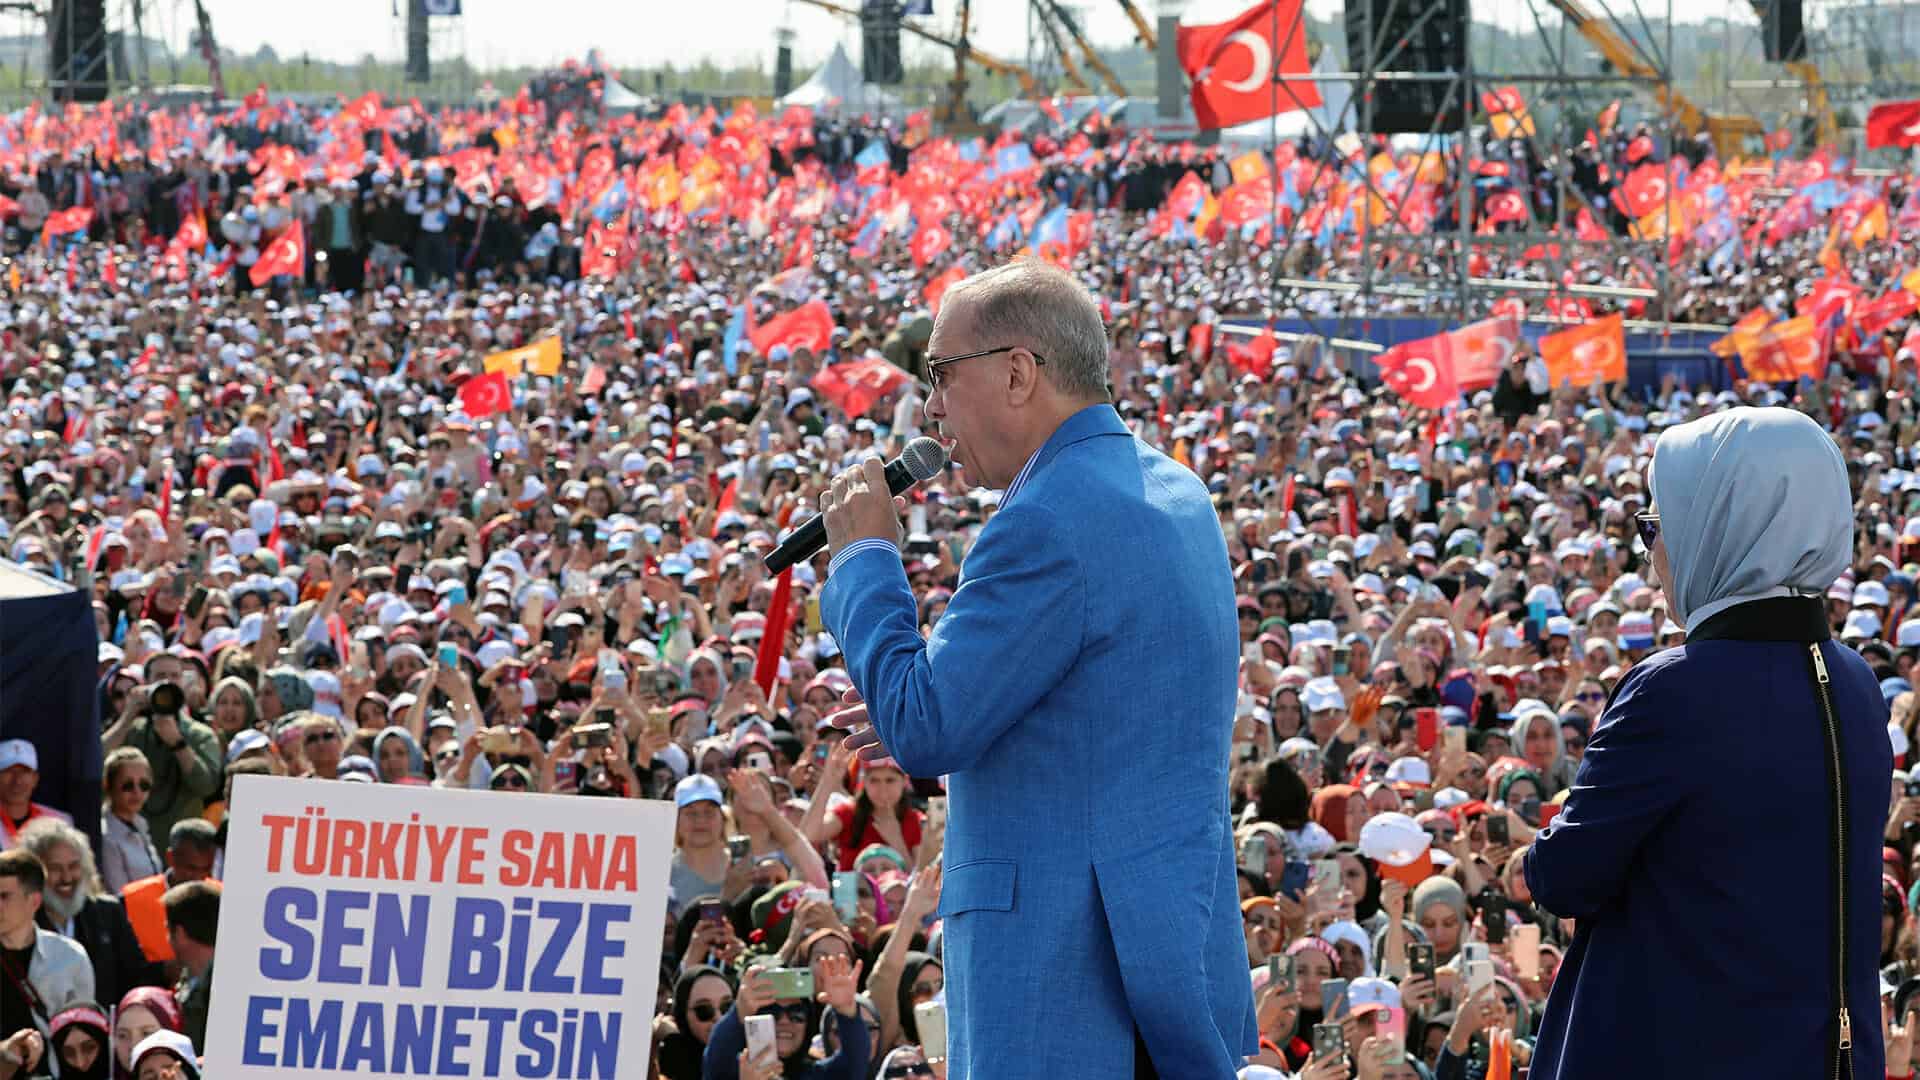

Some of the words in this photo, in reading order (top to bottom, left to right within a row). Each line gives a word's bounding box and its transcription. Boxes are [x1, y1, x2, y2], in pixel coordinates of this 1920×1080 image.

[262, 806, 489, 885] TÜRKİYE
[498, 828, 638, 893] SANA
[259, 886, 430, 988] SEN
